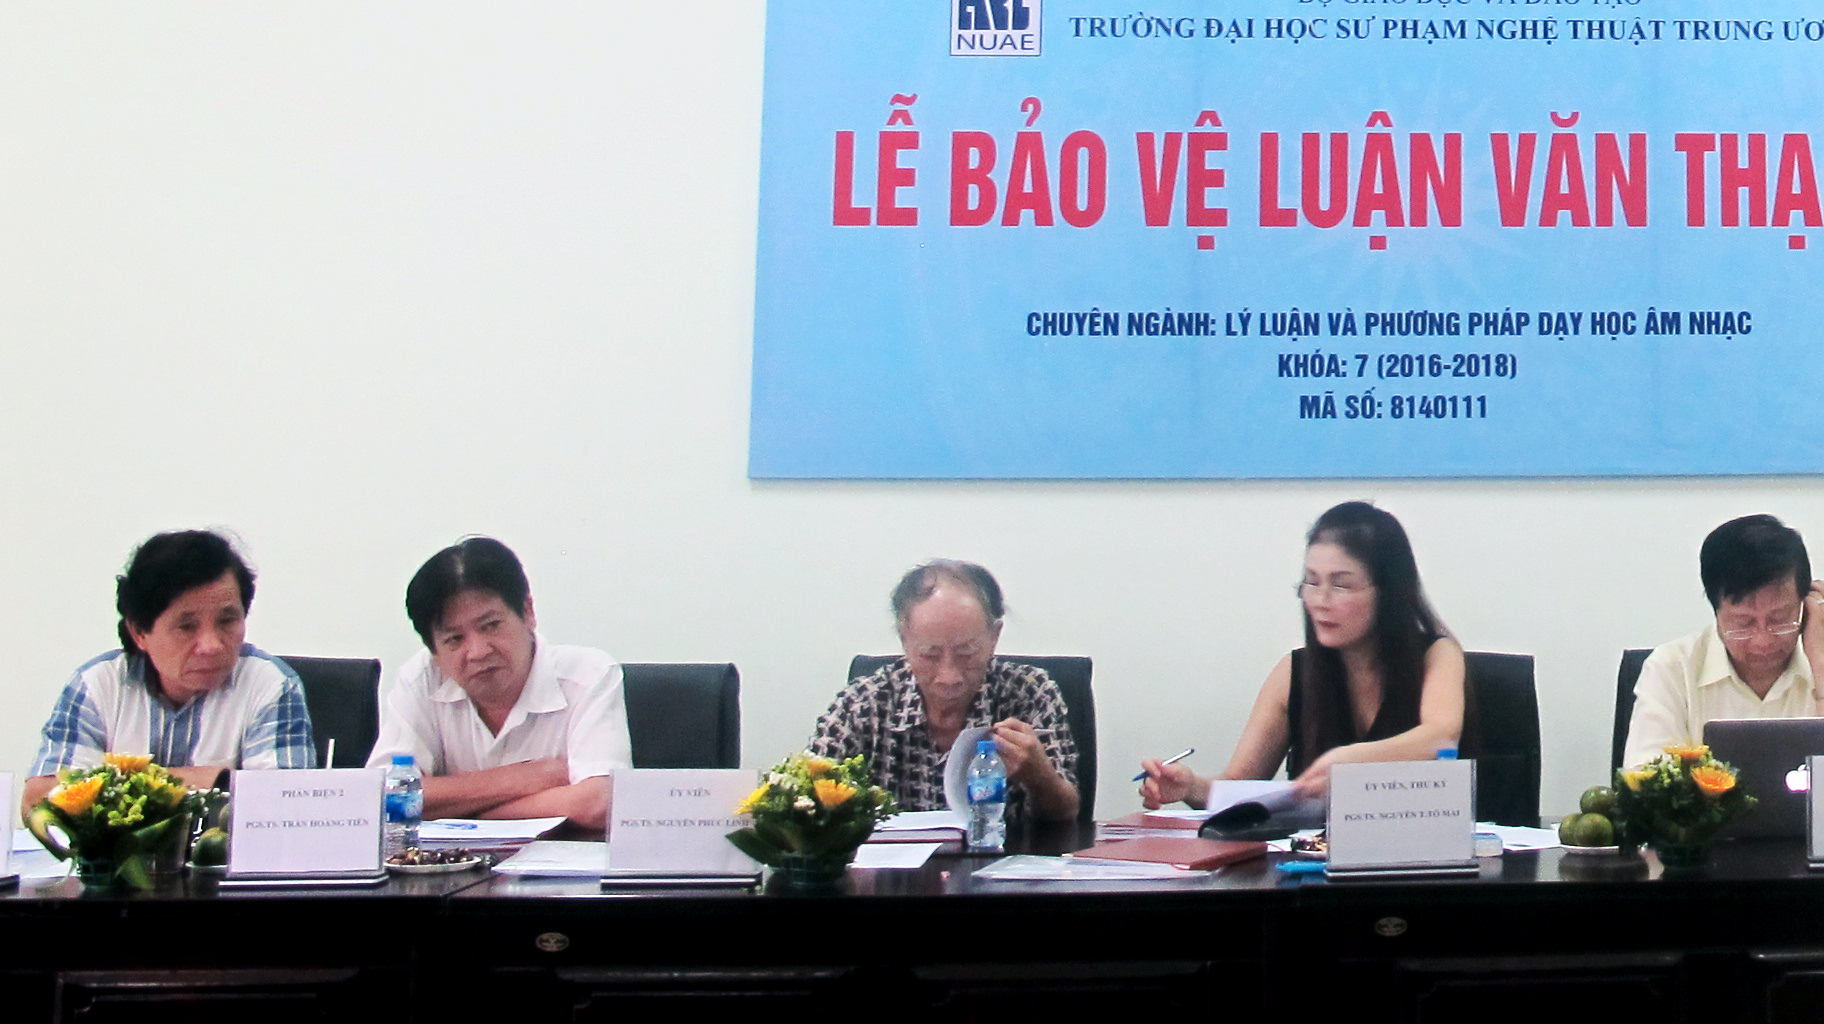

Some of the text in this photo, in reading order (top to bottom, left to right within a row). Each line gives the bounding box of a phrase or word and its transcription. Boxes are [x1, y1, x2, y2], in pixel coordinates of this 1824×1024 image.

[957, 34, 1034, 50] NUAE
[1069, 12, 1195, 39] TRƯỜNG
[1203, 18, 1254, 44] ĐẠI
[1263, 18, 1328, 45] HỌC
[1336, 15, 1376, 40] SƯ
[1382, 18, 1467, 45] PHẠM
[1476, 16, 1559, 46] NGHỆ
[1566, 16, 1667, 46] THUẬT
[1672, 20, 1775, 42] TRUNG
[832, 93, 920, 228] LỄ
[949, 97, 1107, 228] BẢO
[1136, 110, 1229, 250] VỆ
[1259, 110, 1463, 251] LUẬN
[1490, 110, 1648, 229] VĂN
[1026, 306, 1752, 342] CHUYÊN NGÀNH: LÝ LUẬN VÀ PHƯƠNG PHÁP DẠY HỌC ÂM NHẠC
[1277, 349, 1517, 380] KHÓA: 7 (2016-2018)
[1299, 386, 1487, 420] MÃ SỐ: 8140111
